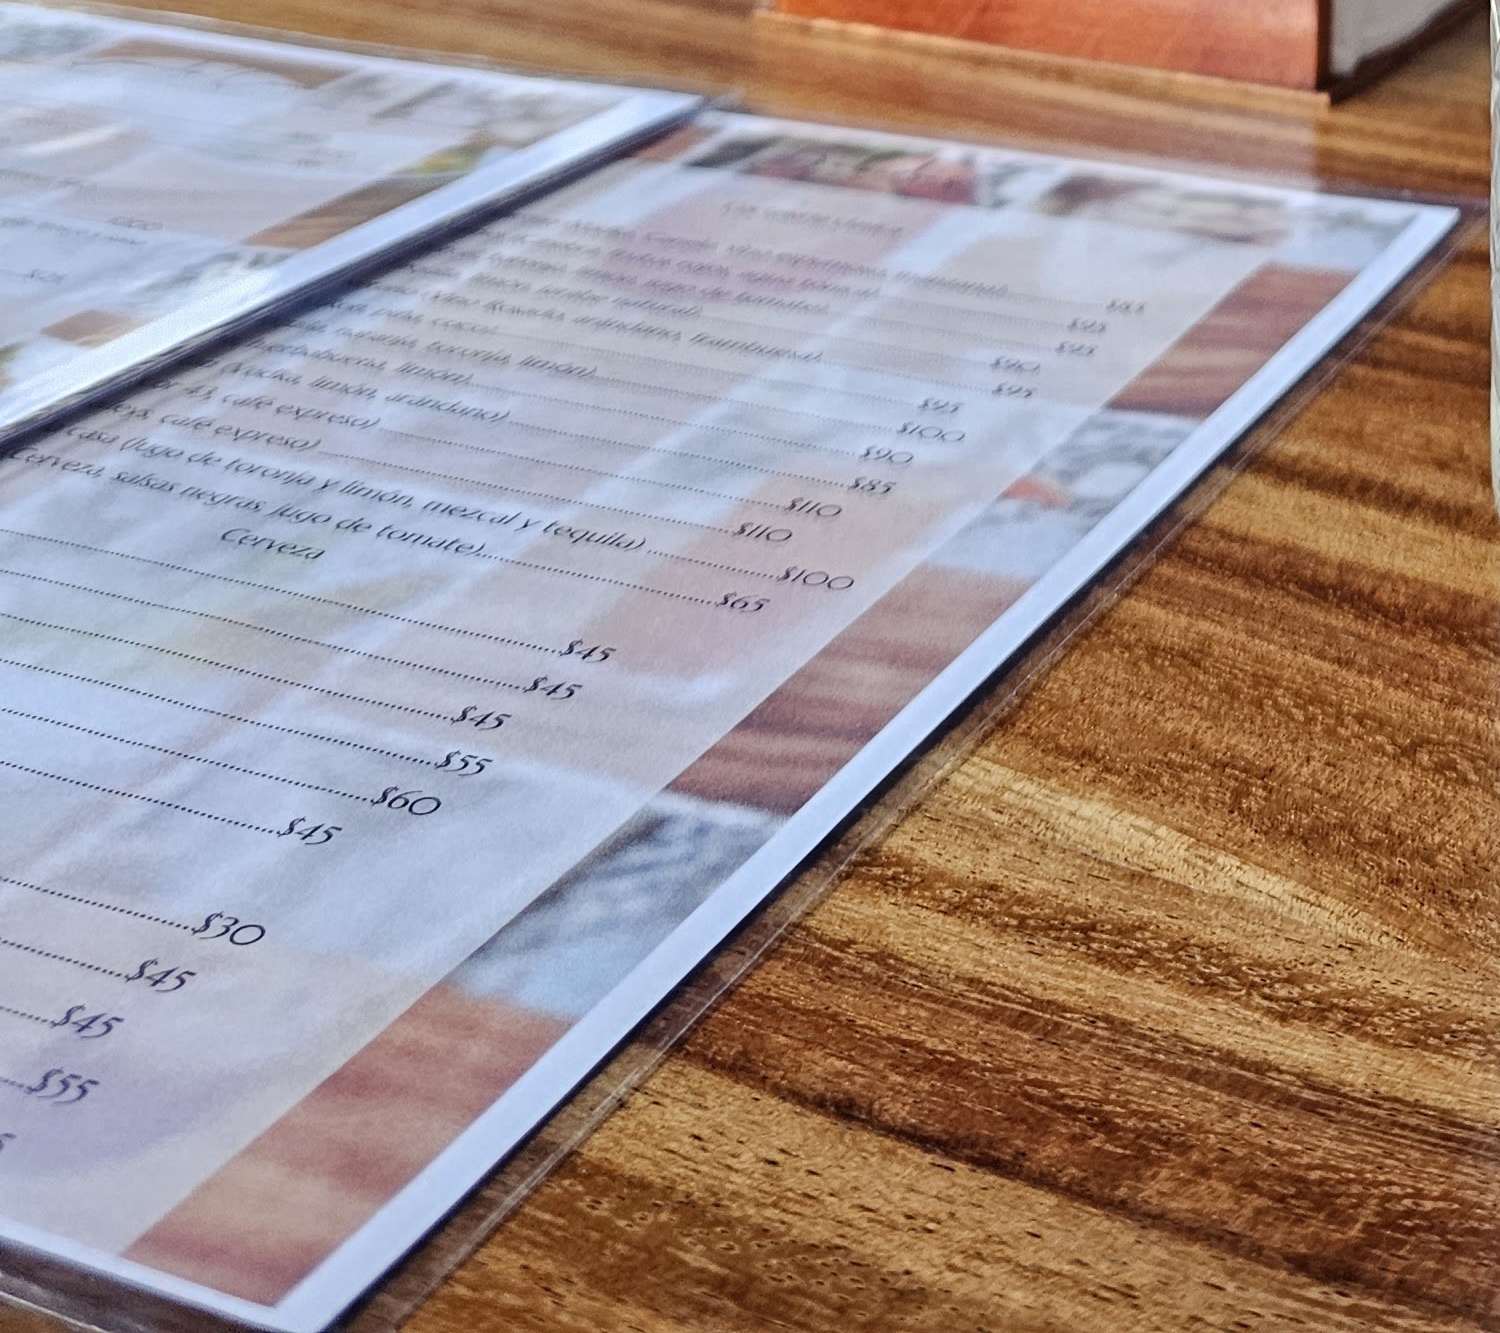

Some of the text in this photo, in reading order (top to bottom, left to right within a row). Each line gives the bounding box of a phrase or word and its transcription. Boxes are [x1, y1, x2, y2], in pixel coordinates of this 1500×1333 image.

[309, 375, 377, 399] limón,
[384, 393, 510, 423] arándano)
[847, 476, 897, 495] $85
[896, 420, 966, 442] $100
[275, 404, 380, 430] expreso)
[784, 497, 842, 518] $110
[859, 444, 914, 464] $90
[159, 414, 793, 543] café expreso) $110
[65, 427, 120, 444] casa
[187, 450, 222, 466] de
[224, 458, 316, 486] toronja
[316, 479, 340, 493] y
[339, 480, 414, 510] limón,
[422, 499, 522, 526] mezcal
[513, 518, 541, 532] y
[542, 520, 647, 553] tequila)
[778, 565, 855, 591] $100
[111, 470, 176, 493] salsas
[178, 486, 267, 513] negras,
[336, 517, 372, 534] de
[376, 524, 486, 556] tomate)
[717, 591, 772, 613] $65
[220, 528, 327, 561] Cerveza
[560, 638, 617, 663] $45
[524, 675, 583, 701] $45
[452, 704, 513, 731] $45
[434, 749, 493, 777] $55
[371, 785, 442, 816] $60
[277, 816, 343, 846] $45
[191, 911, 266, 946] $30
[124, 957, 197, 993] $45
[50, 1004, 124, 1039] $45
[25, 1067, 101, 1106] $55
